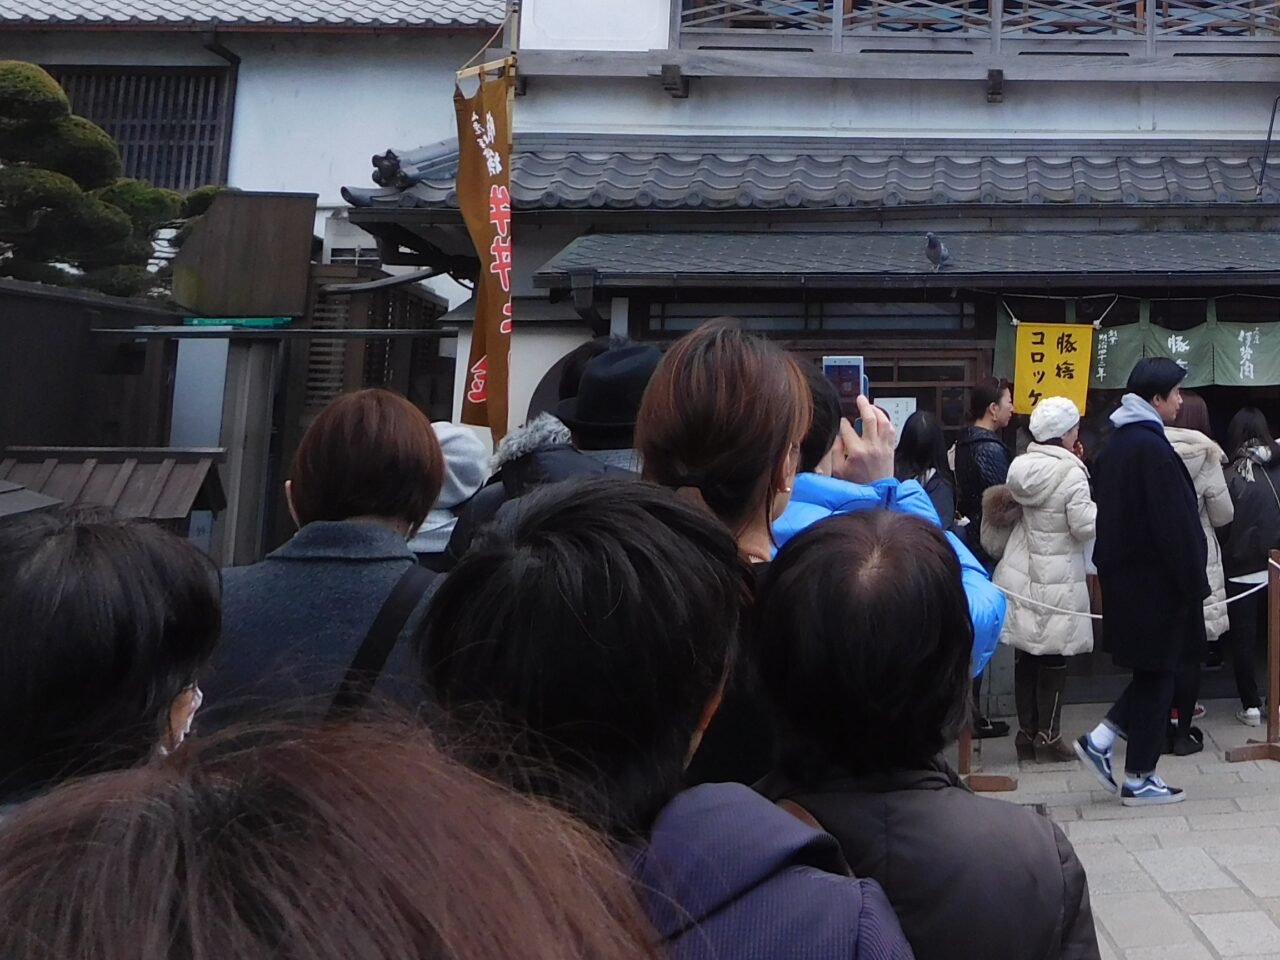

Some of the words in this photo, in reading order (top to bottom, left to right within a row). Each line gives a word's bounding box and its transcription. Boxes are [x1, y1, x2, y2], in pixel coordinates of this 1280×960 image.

[1028, 331, 1046, 407] コロッケ
[1055, 331, 1078, 380] 豚捨
